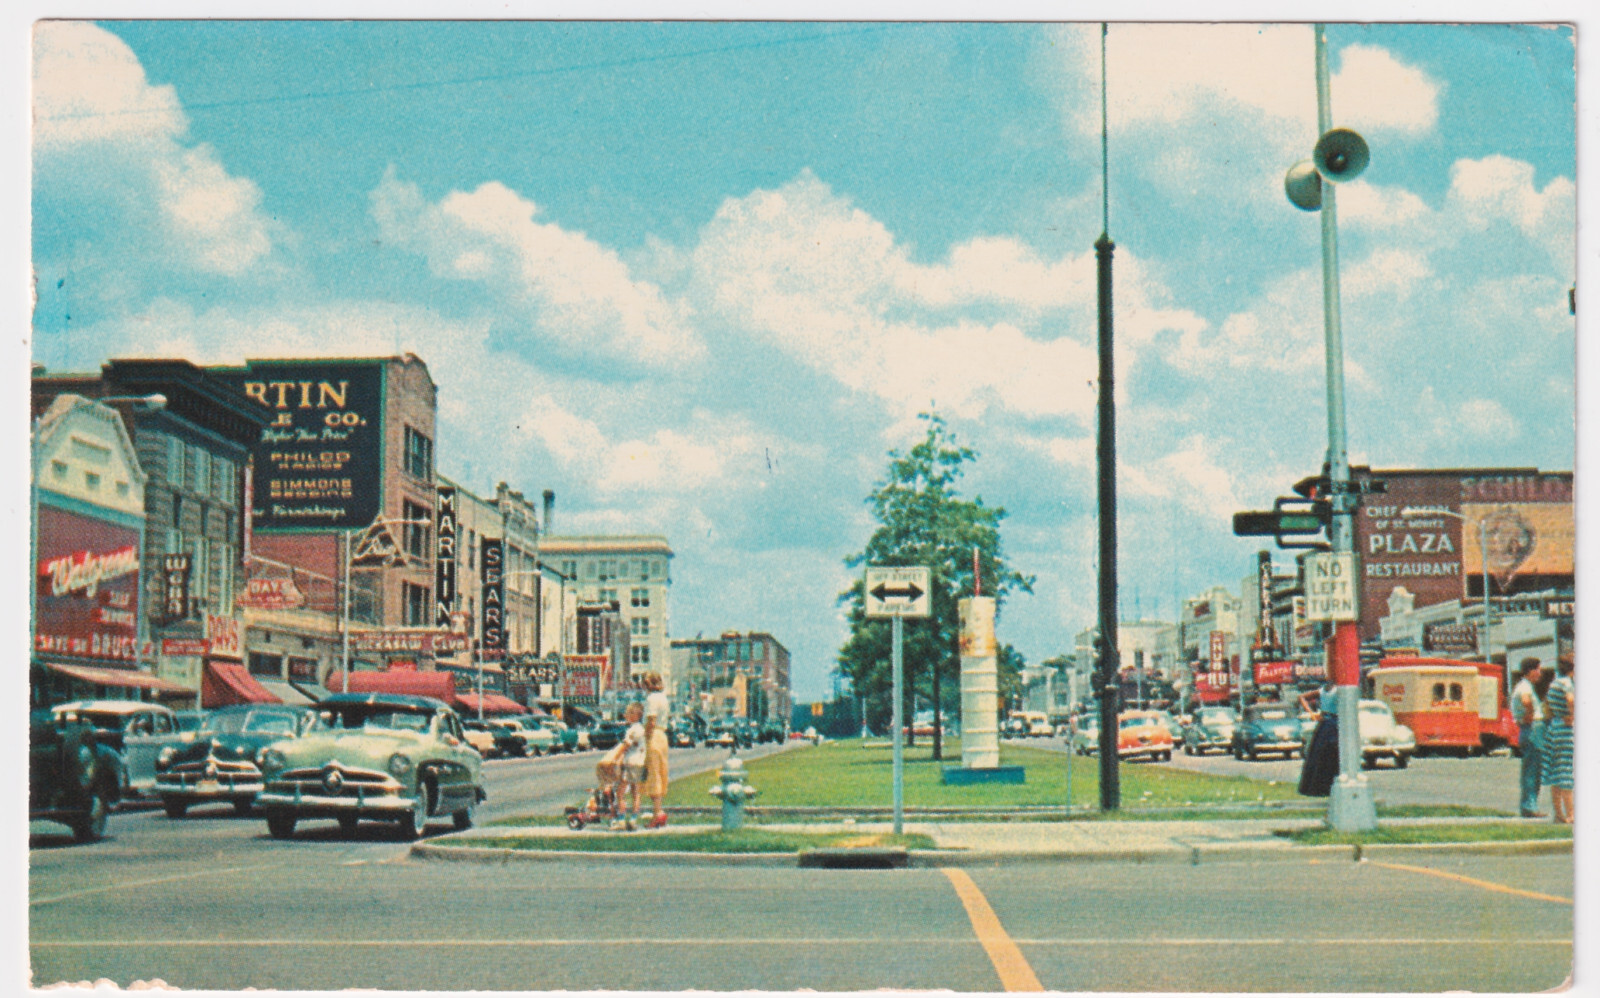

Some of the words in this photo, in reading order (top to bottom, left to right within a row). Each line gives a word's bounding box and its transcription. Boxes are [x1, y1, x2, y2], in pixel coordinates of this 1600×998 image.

[245, 382, 348, 408] RTIN
[325, 412, 367, 427] CO.
[270, 479, 352, 491] SIMMONS
[1369, 533, 1454, 554] PLAZA
[1316, 561, 1342, 577] NO
[1366, 562, 1461, 577] RESTAURANT
[1311, 582, 1347, 595] LEFT
[485, 547, 501, 646] SEARS
[1311, 600, 1352, 612] TURN
